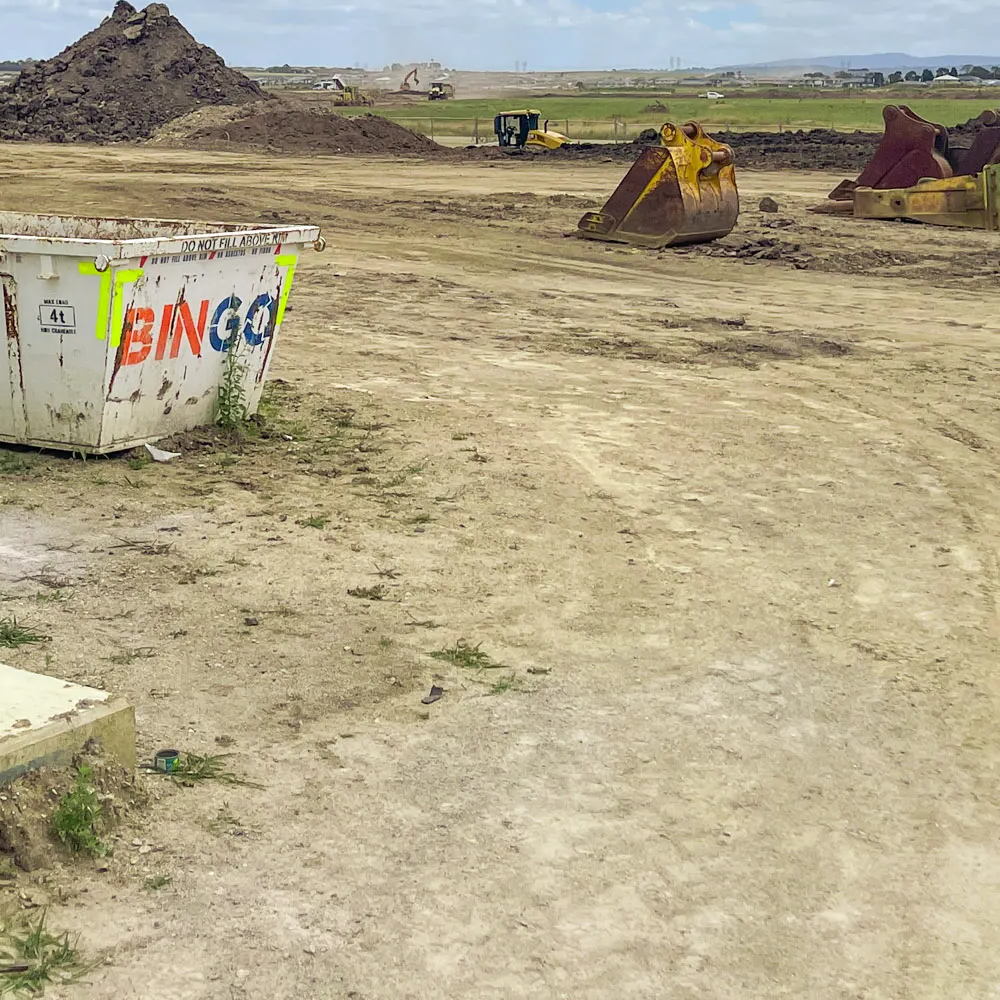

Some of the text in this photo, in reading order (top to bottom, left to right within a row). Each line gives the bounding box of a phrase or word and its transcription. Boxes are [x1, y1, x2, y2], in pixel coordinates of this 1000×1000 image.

[181, 240, 196, 252] DO
[198, 239, 218, 251] NOT
[219, 237, 237, 249] FILL
[239, 234, 270, 247] ABOVE
[121, 291, 276, 366] BINGO
